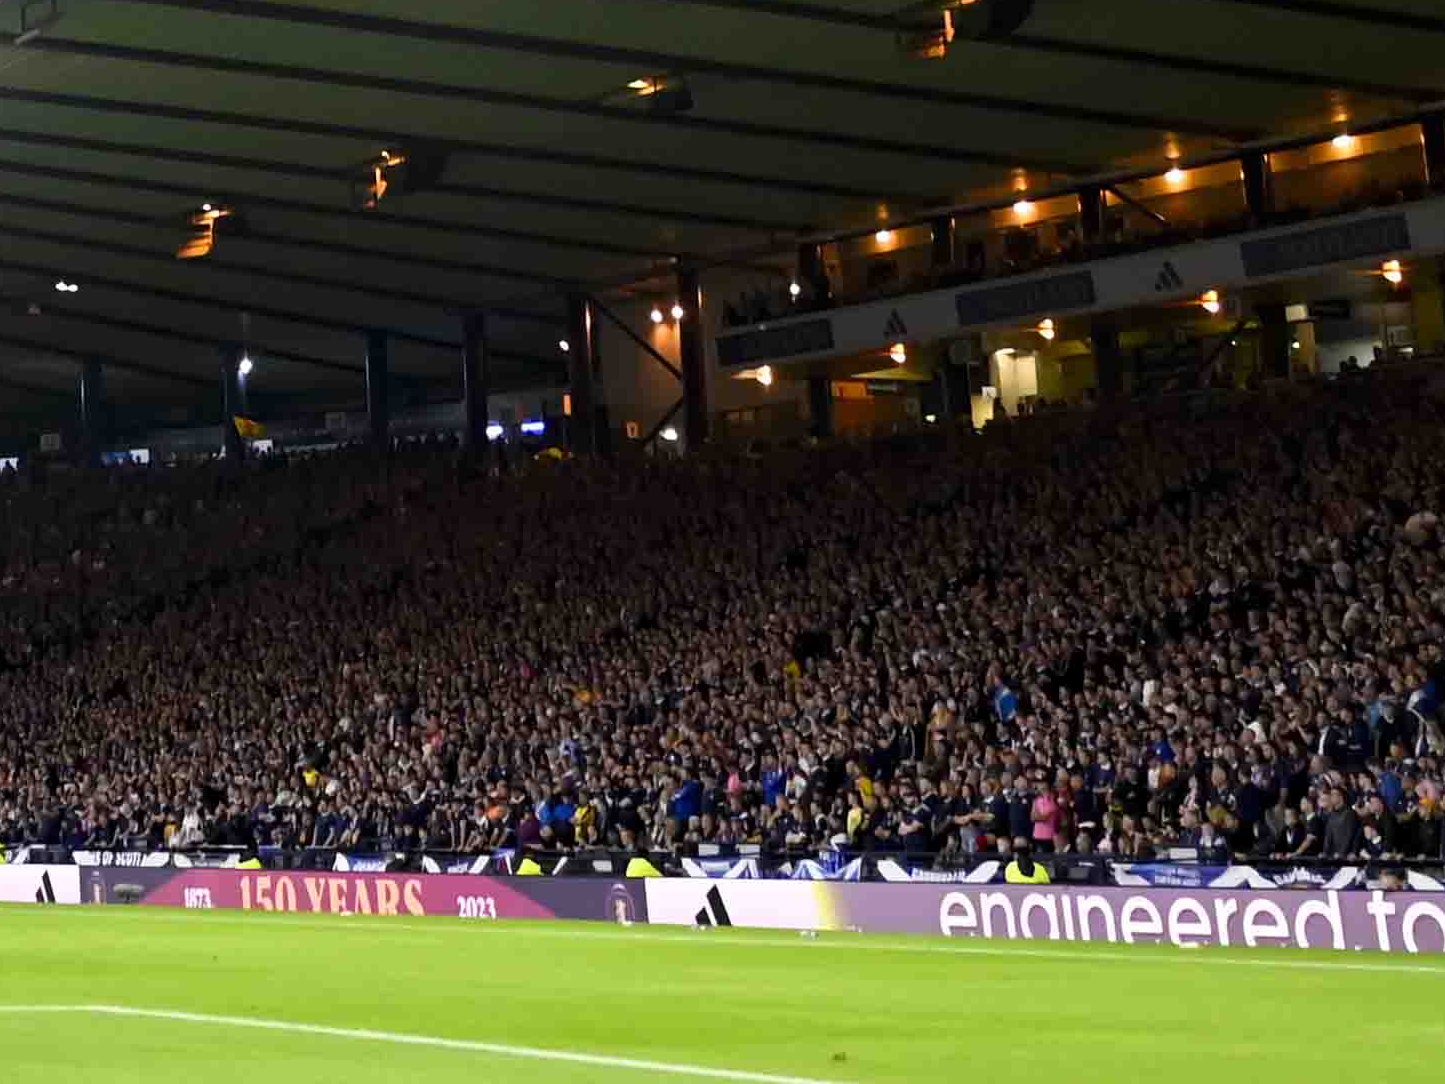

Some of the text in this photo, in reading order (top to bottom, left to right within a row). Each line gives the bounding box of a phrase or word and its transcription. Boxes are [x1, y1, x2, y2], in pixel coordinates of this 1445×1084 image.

[239, 875, 426, 916] 150 YEARS
[457, 895, 497, 919] 2023
[939, 890, 1346, 950] engineered
